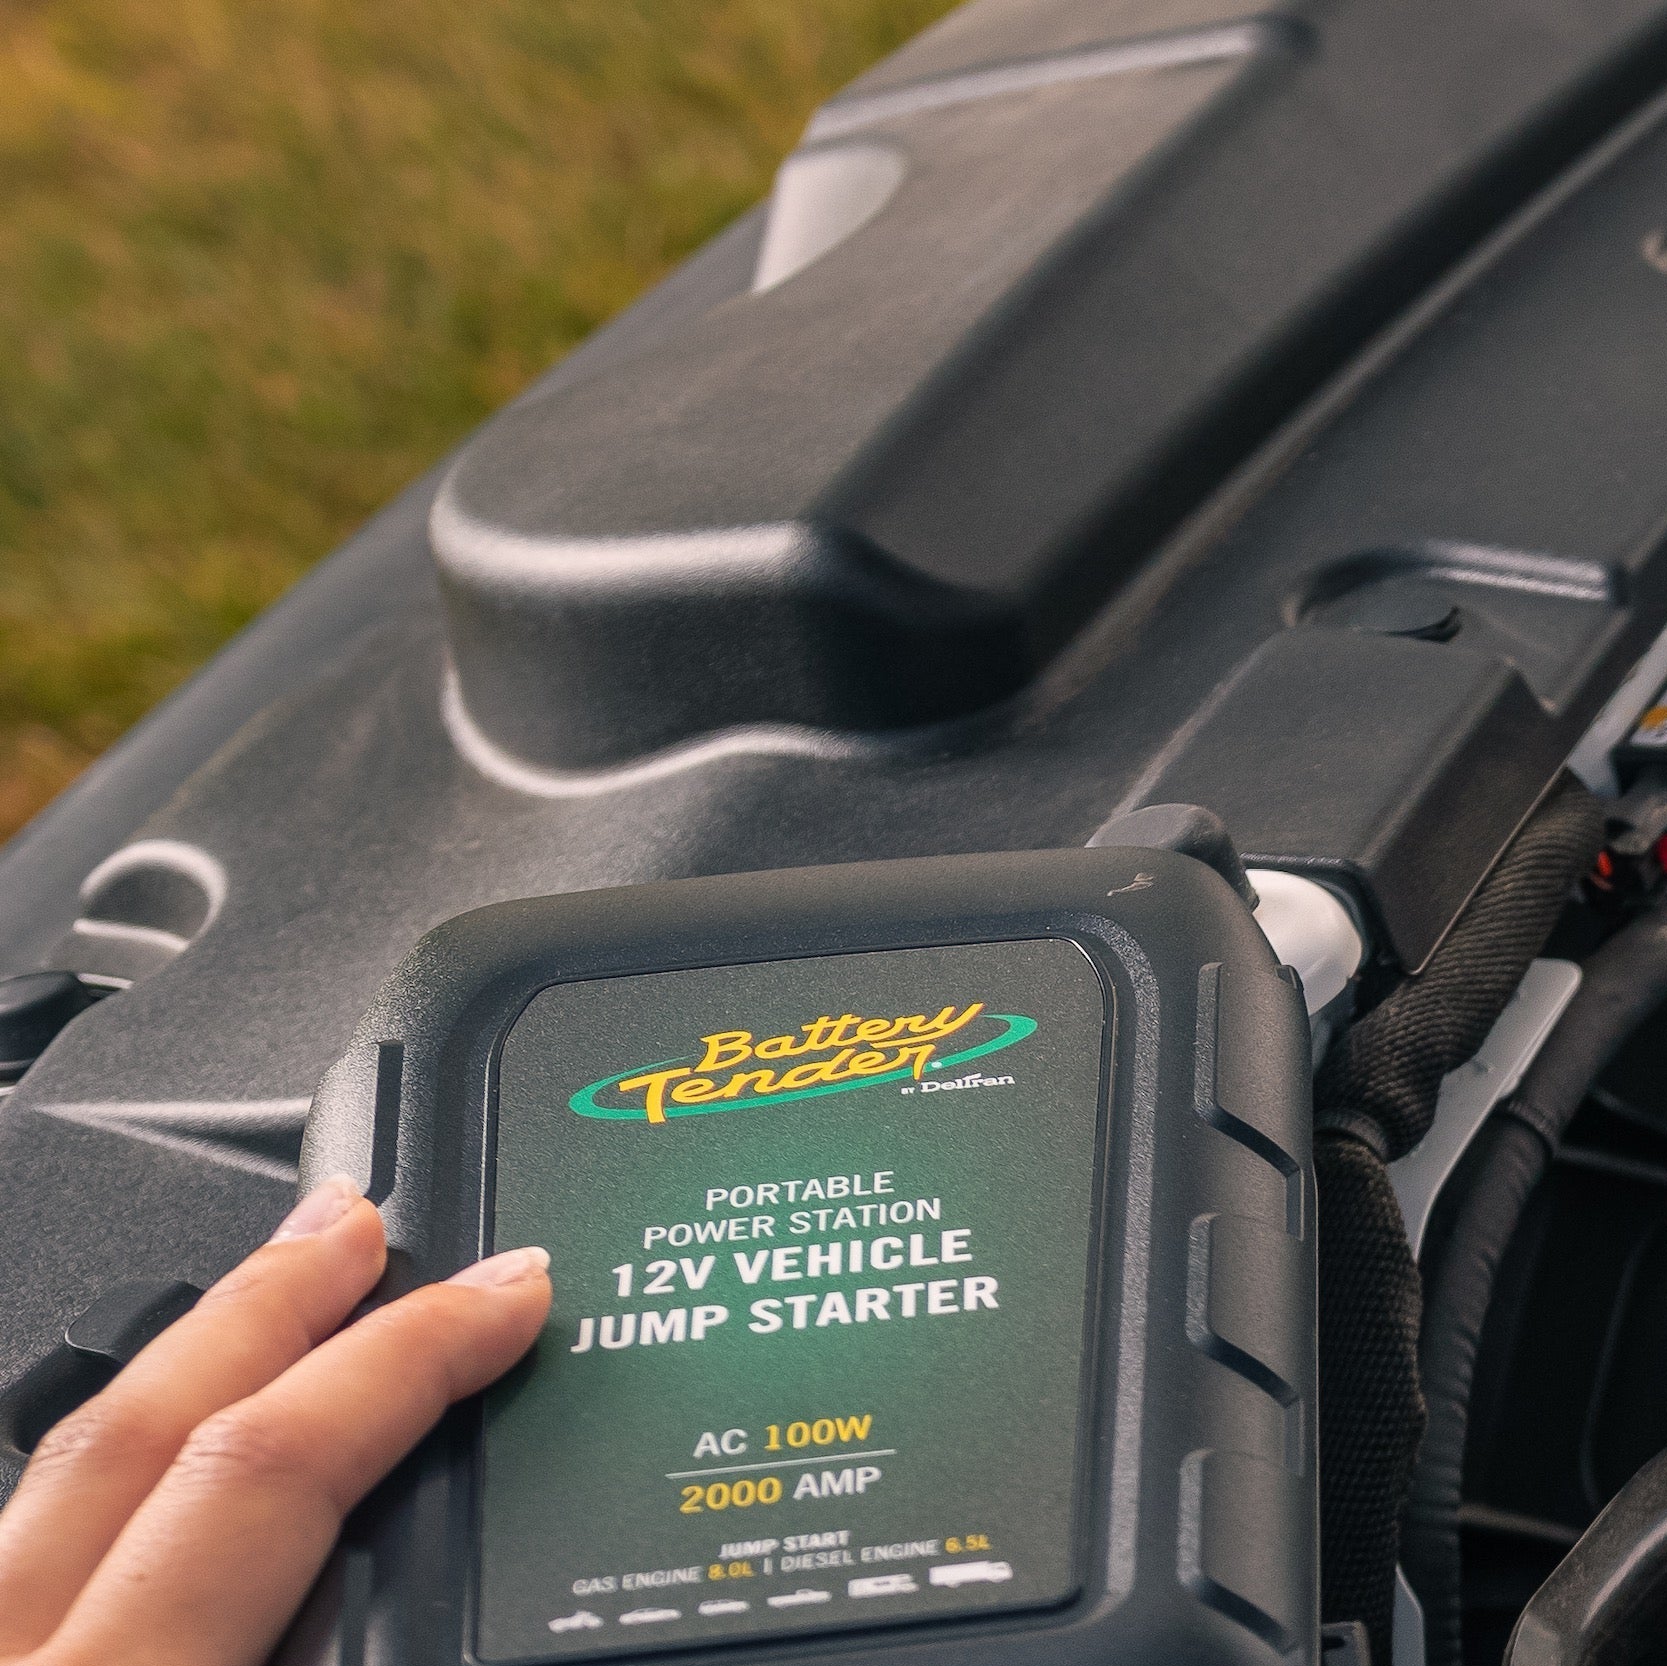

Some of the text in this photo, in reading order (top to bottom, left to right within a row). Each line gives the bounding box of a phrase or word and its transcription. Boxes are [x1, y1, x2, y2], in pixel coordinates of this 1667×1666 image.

[694, 1001, 984, 1074] Battery
[617, 1042, 937, 1124] Tender
[706, 1170, 896, 1211] PORTABLE
[642, 1196, 942, 1251] POWER STATION
[610, 1228, 973, 1299] 12V VEHICLE
[569, 1275, 1001, 1355] JUMP STARTER
[692, 1414, 873, 1459] AC 100W
[679, 1465, 883, 1516] 2000 AMP
[571, 1576, 618, 1596] GAS
[621, 1565, 703, 1590] ENGINE
[780, 1547, 855, 1573] DIESEL
[860, 1538, 940, 1563] ENGINE
[717, 1529, 851, 1560] JUMP START
